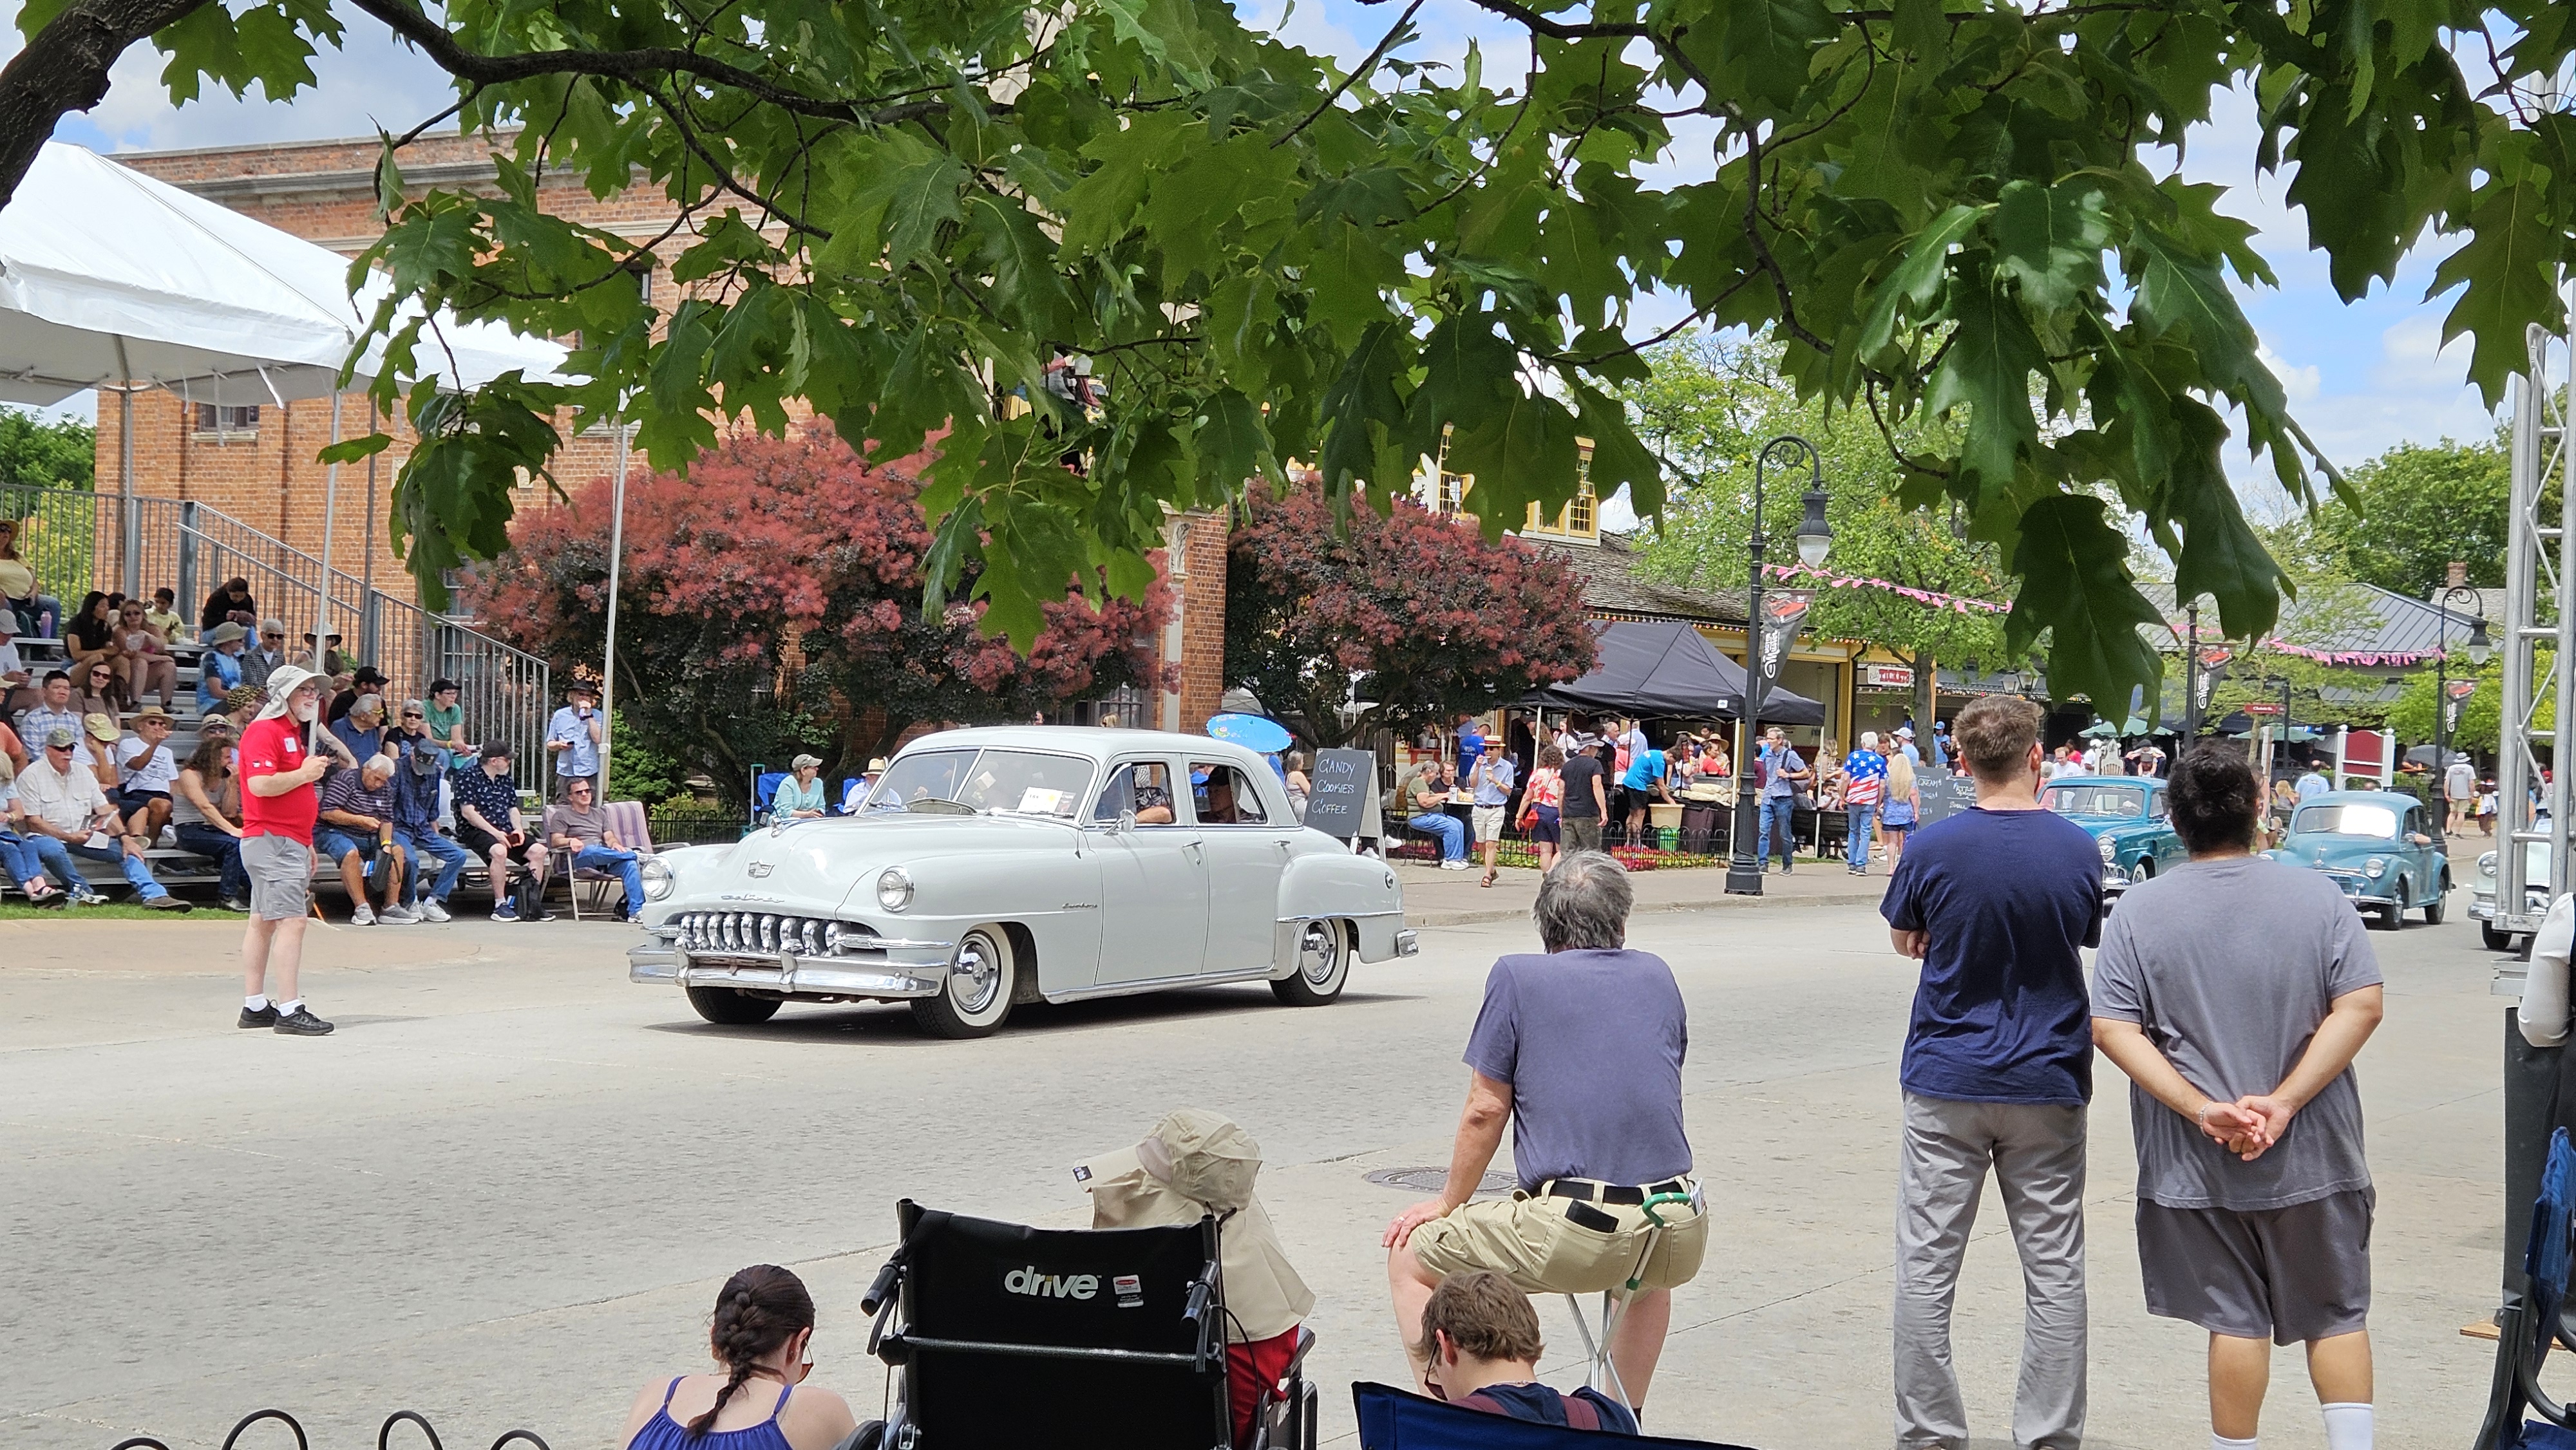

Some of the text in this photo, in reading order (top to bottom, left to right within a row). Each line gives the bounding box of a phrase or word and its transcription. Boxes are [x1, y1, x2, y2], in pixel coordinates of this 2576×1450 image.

[1318, 758, 1356, 781] CANDY
[1316, 779, 1354, 794] COOKIES
[1312, 798, 1347, 814] COFFEE
[1004, 1265, 1099, 1299] drive
